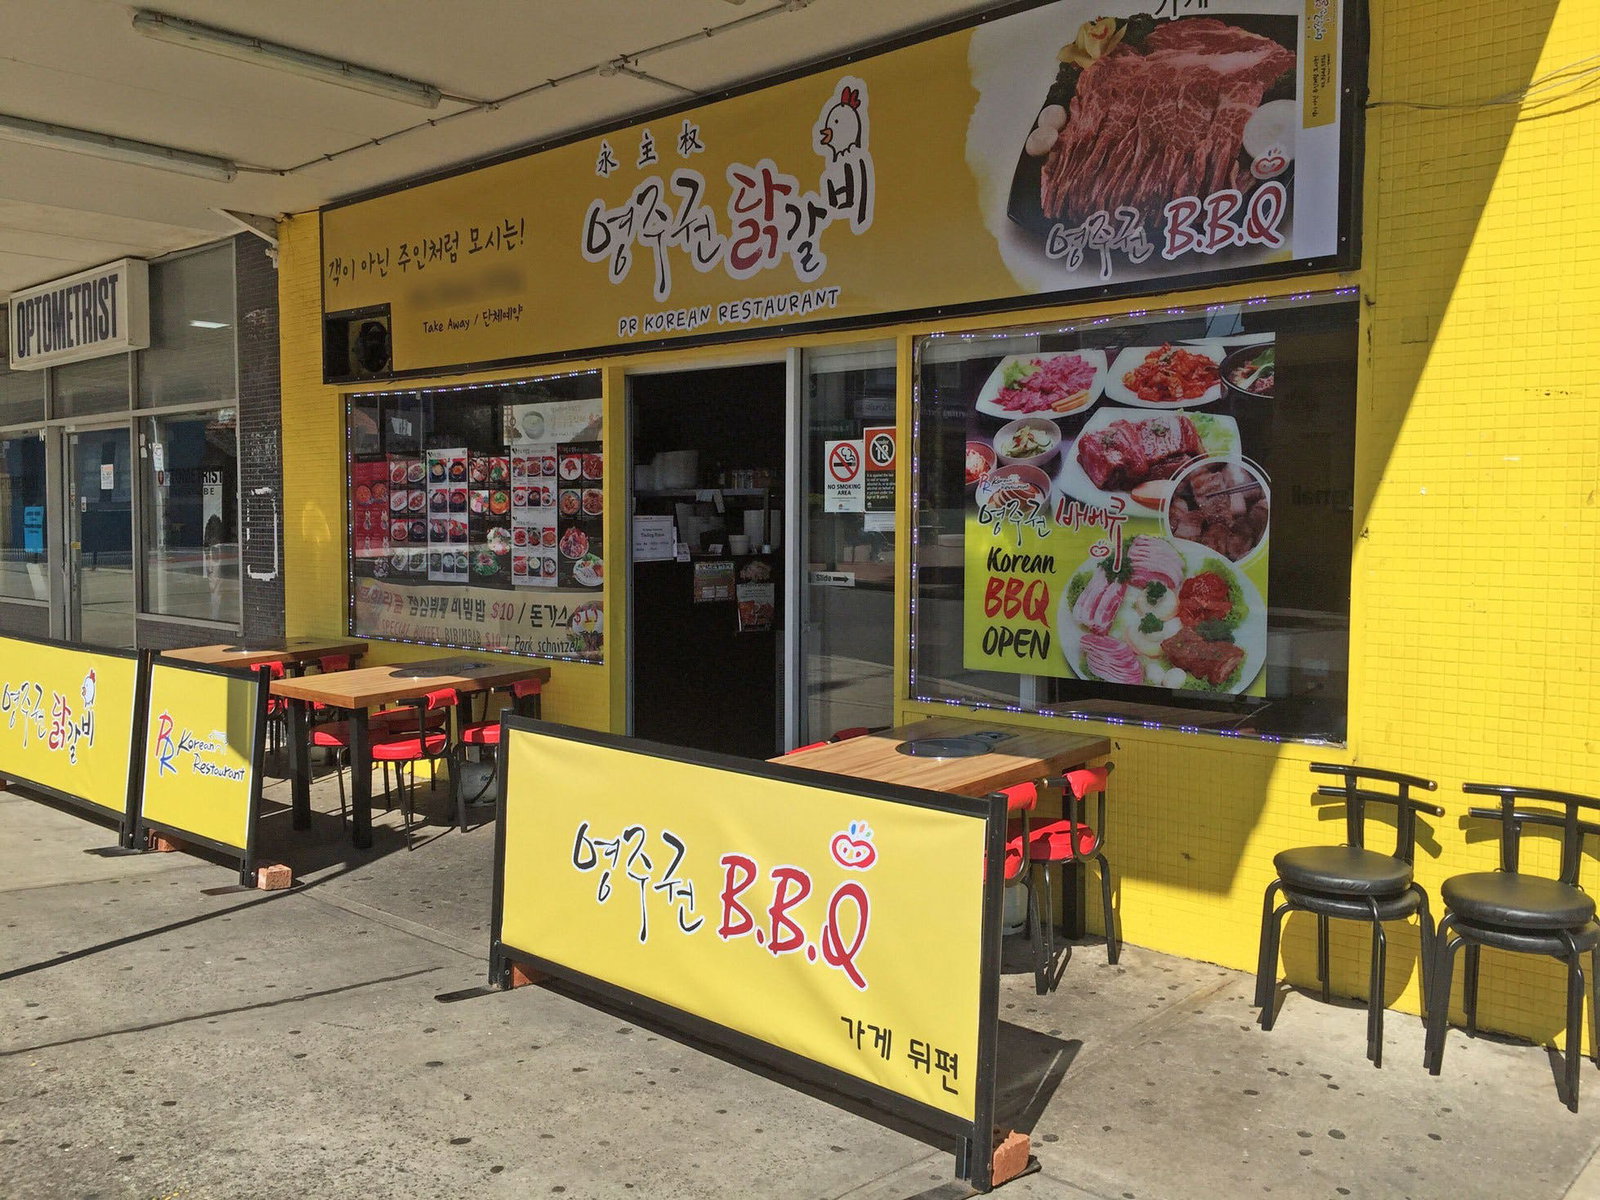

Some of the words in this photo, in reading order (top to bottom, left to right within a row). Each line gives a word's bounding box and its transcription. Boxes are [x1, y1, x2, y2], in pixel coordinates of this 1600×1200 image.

[587, 177, 721, 293] 영주권
[730, 159, 867, 272] 닭갈비
[1166, 186, 1281, 255] B.B.Q
[329, 257, 355, 287] 객이
[361, 247, 389, 277] 아닌
[398, 230, 459, 272] 주인처럼
[468, 217, 524, 254] 모시는!
[16, 274, 119, 358] OPTOMETRIST
[423, 320, 444, 334] Take
[448, 318, 470, 331] Away
[482, 304, 523, 328] 단체예약
[619, 317, 637, 335] PR
[645, 308, 710, 331] KOREAN
[719, 289, 839, 321] RESTAURANT
[979, 499, 1051, 547] 영주권
[986, 546, 1057, 574] Korean
[451, 598, 486, 622] 비빔밥
[490, 601, 515, 621] $10
[517, 602, 527, 624] /
[984, 576, 1051, 629] BBQ
[514, 635, 533, 652] Pork
[538, 636, 578, 653] schnitzel
[982, 626, 1051, 660] OPEN
[49, 692, 95, 764] 닭갈비
[176, 729, 215, 756] Korean
[193, 752, 246, 780] Restaurant
[572, 822, 704, 942] 영주권
[718, 855, 869, 989] B.B.Q
[840, 1016, 892, 1061] 가게
[907, 1038, 959, 1096] 뒤편
